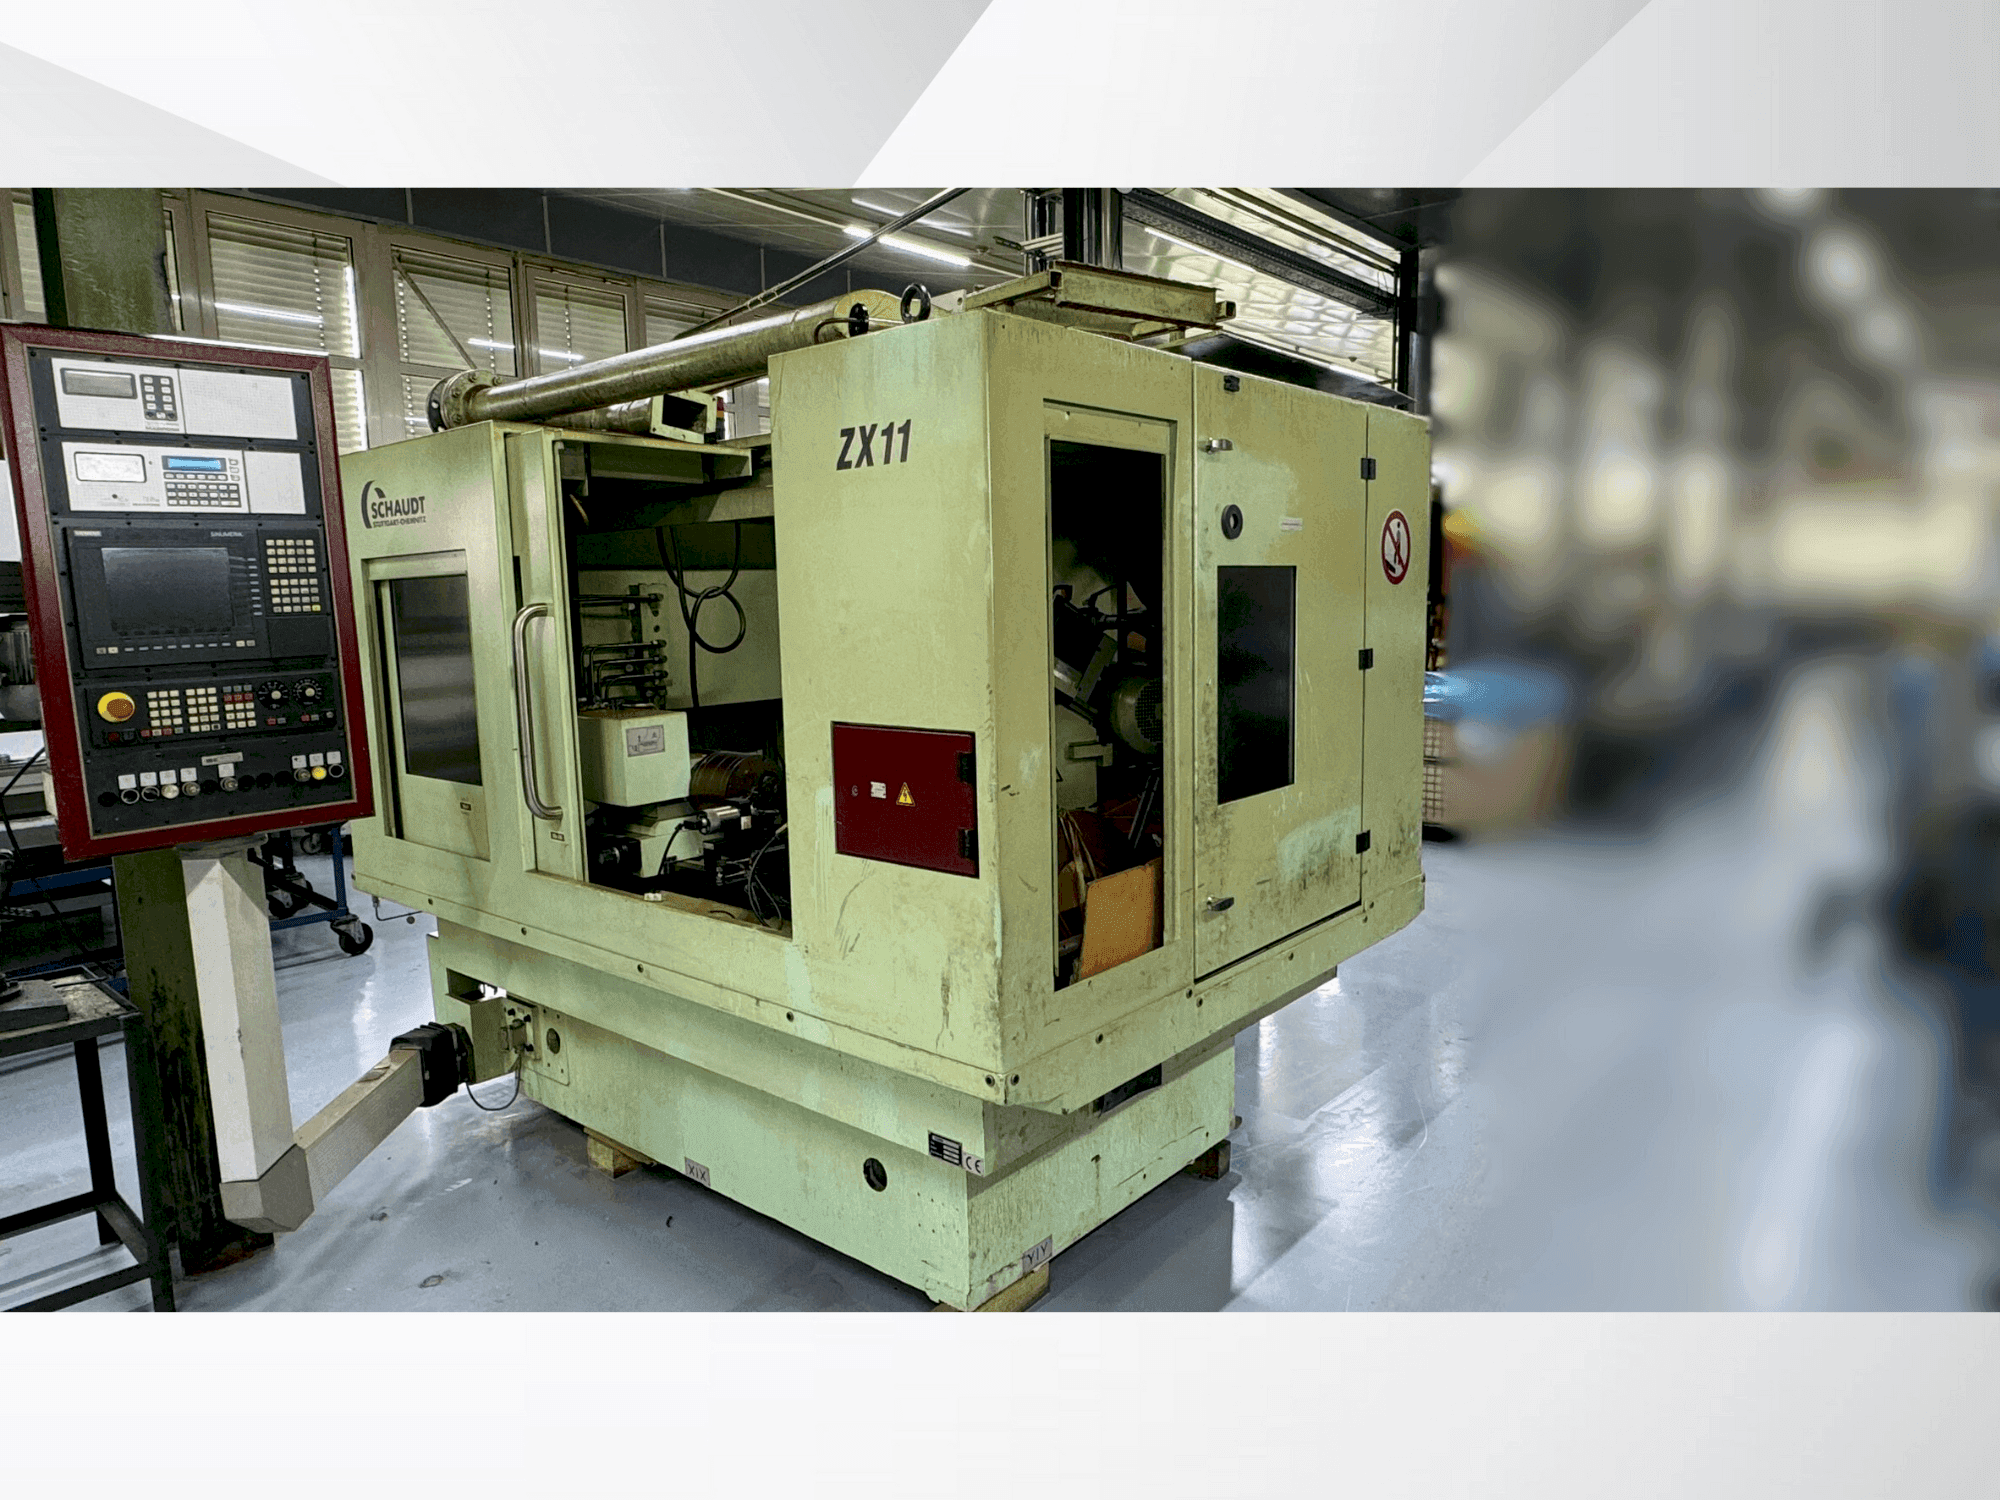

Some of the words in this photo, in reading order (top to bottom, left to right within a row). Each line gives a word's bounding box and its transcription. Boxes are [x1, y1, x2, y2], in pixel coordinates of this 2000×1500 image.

[836, 418, 912, 471] ZX11
[371, 496, 425, 519] SCHAUDT
[965, 1156, 981, 1174] CE
